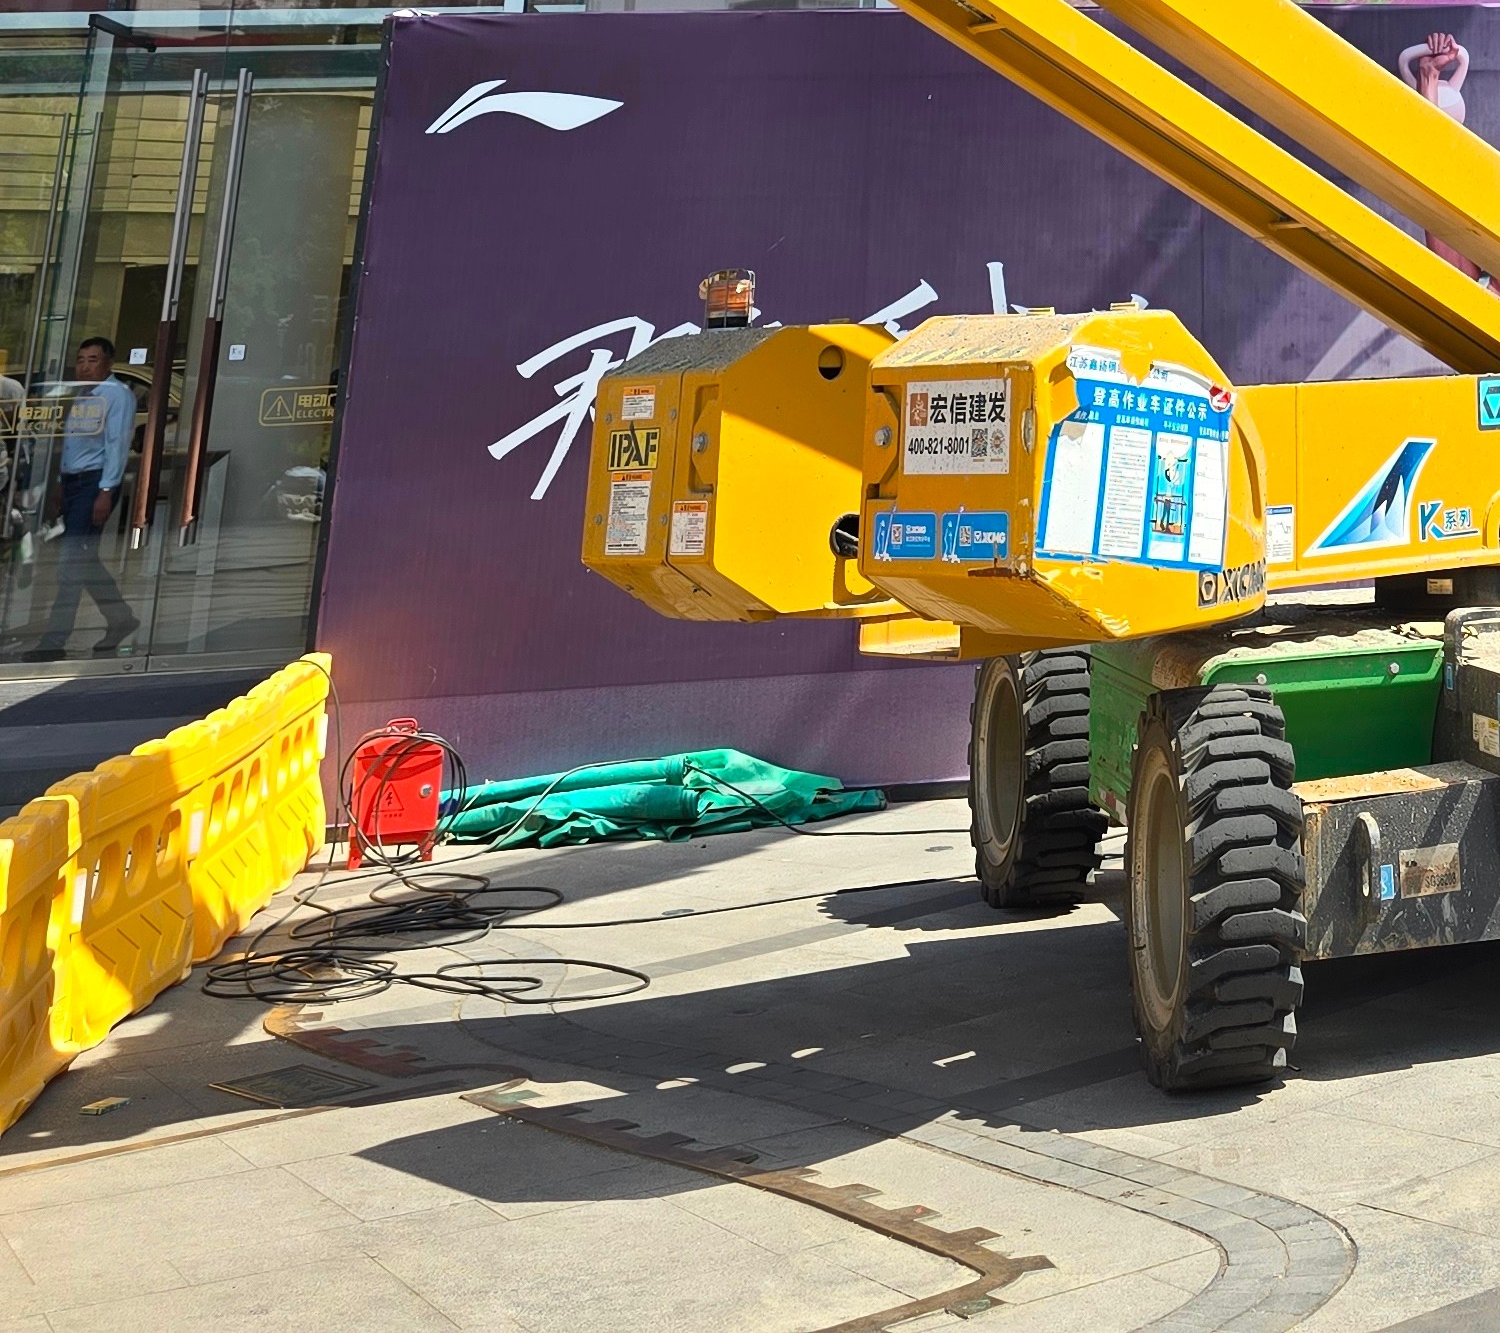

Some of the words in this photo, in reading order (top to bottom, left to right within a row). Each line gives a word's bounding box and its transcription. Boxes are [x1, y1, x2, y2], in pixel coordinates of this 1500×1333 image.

[930, 391, 1006, 424] 宏信建发
[609, 422, 658, 468] IPAF
[907, 436, 970, 455] 400-821-8001
[1420, 502, 1478, 540] K系列
